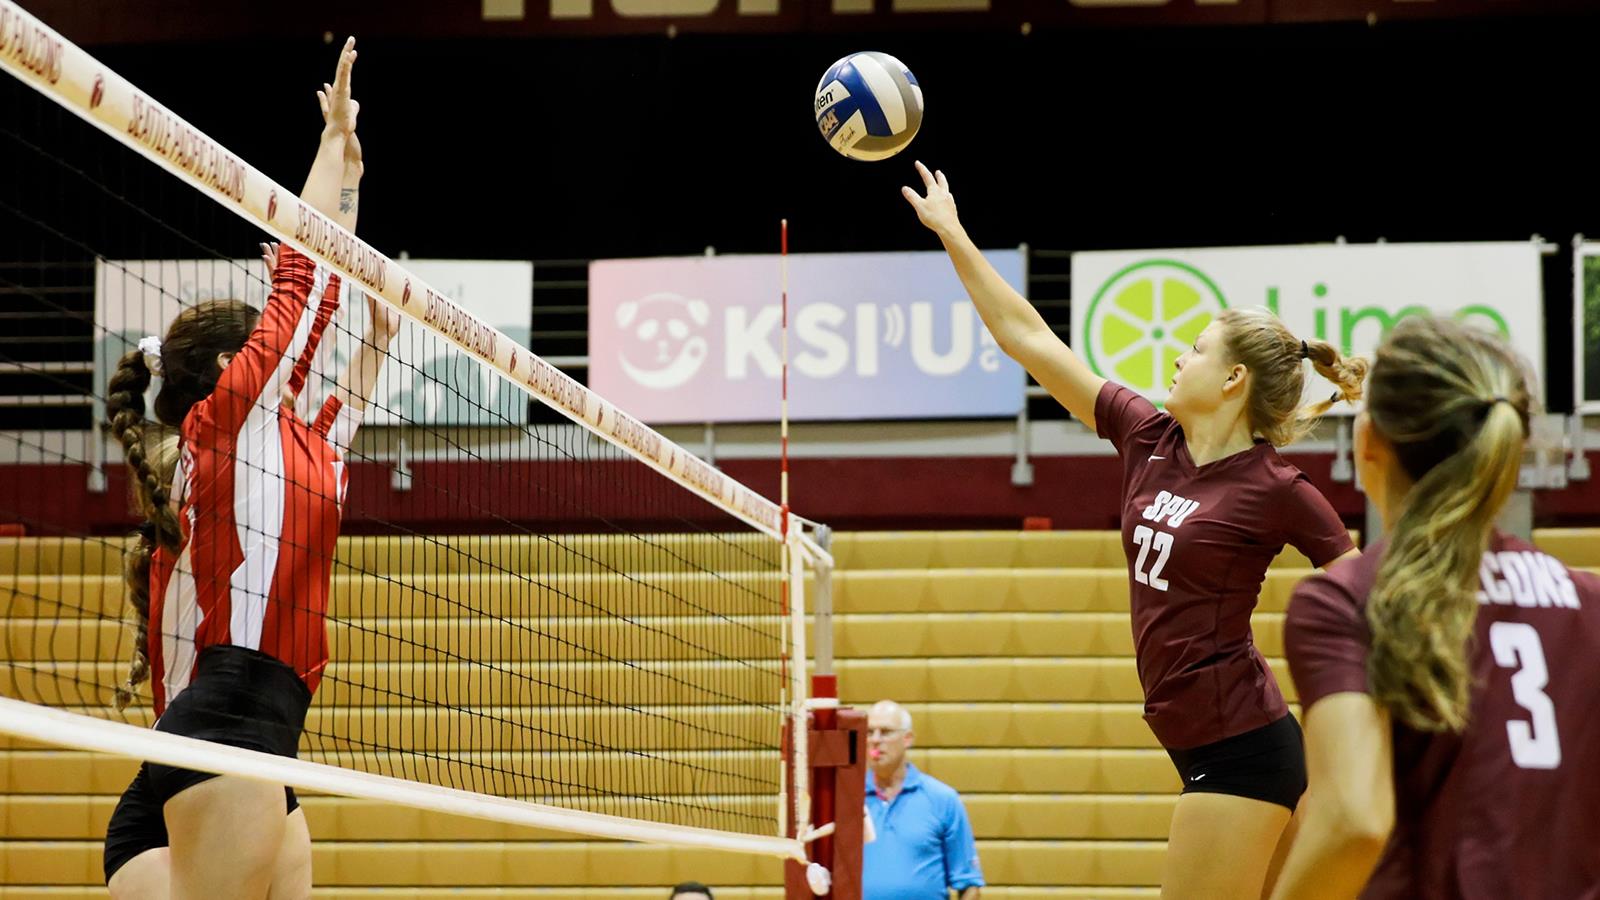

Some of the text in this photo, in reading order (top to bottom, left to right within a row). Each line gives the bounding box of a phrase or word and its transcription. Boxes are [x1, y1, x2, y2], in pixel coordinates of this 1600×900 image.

[1142, 490, 1200, 528] SPU
[1133, 525, 1174, 592] 22
[1475, 551, 1581, 609] CONS
[1489, 621, 1562, 769] 3
